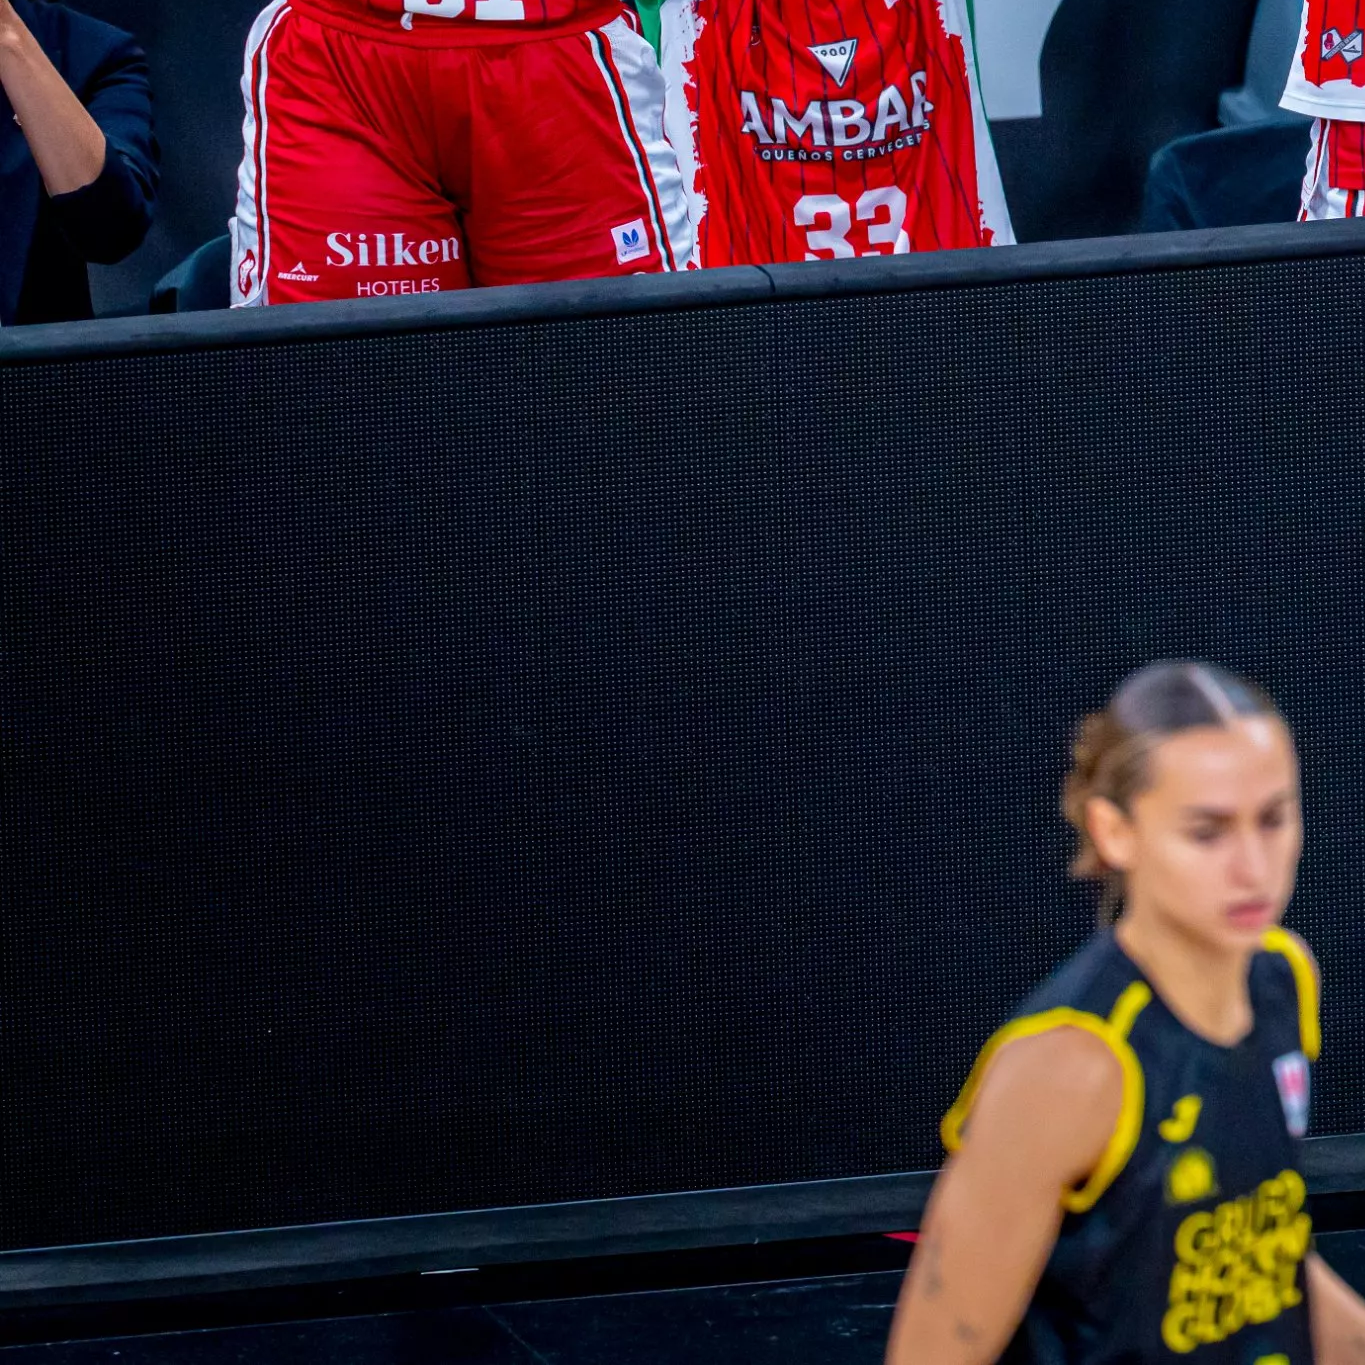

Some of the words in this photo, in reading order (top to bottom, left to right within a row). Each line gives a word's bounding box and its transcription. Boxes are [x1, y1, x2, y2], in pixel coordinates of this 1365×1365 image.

[815, 46, 847, 57] 900
[756, 147, 833, 161] QUEÑOS
[793, 185, 910, 262] 33
[326, 232, 460, 267] Silken
[278, 271, 319, 282] MERCURY
[357, 278, 440, 296] HOTELES
